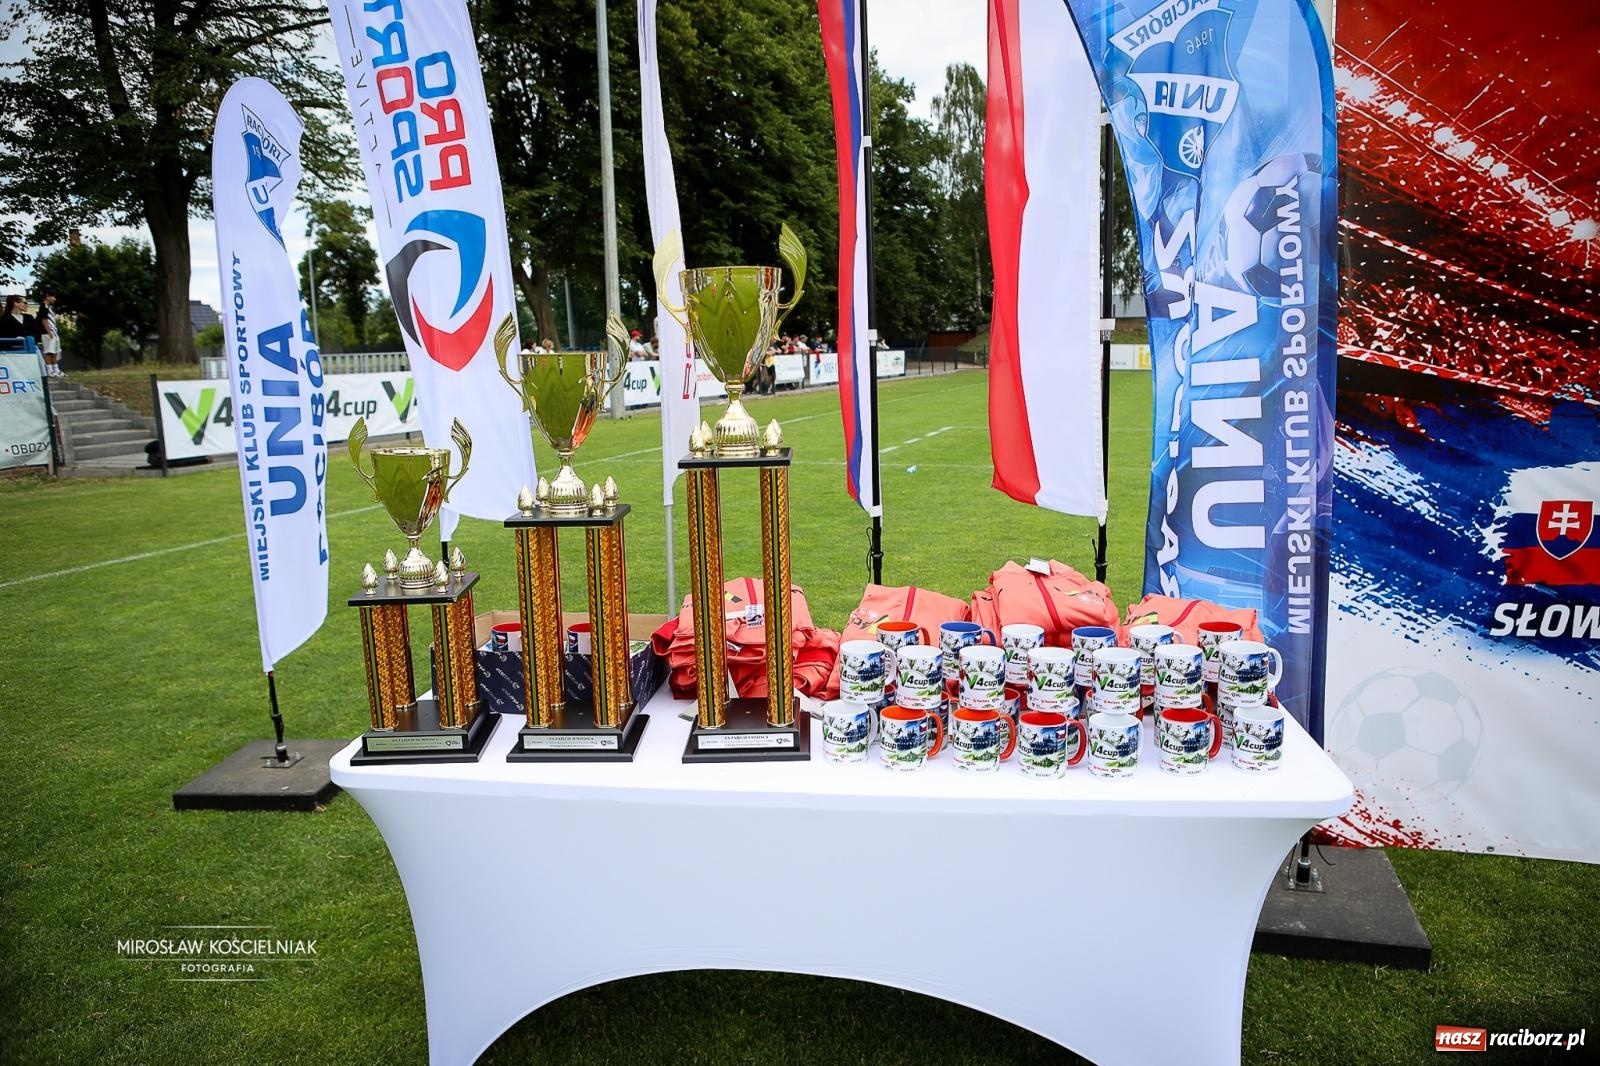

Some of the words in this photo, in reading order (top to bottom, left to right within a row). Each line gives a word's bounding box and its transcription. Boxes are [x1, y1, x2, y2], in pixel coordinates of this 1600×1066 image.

[233, 250, 253, 395] SPORTOWY
[326, 390, 377, 420] 4cup
[624, 371, 647, 392] 4cup
[11, 441, 50, 455] OBOZY
[242, 403, 260, 471] KLUB
[257, 321, 307, 517] UNIA
[249, 480, 270, 582] MIEJSKI
